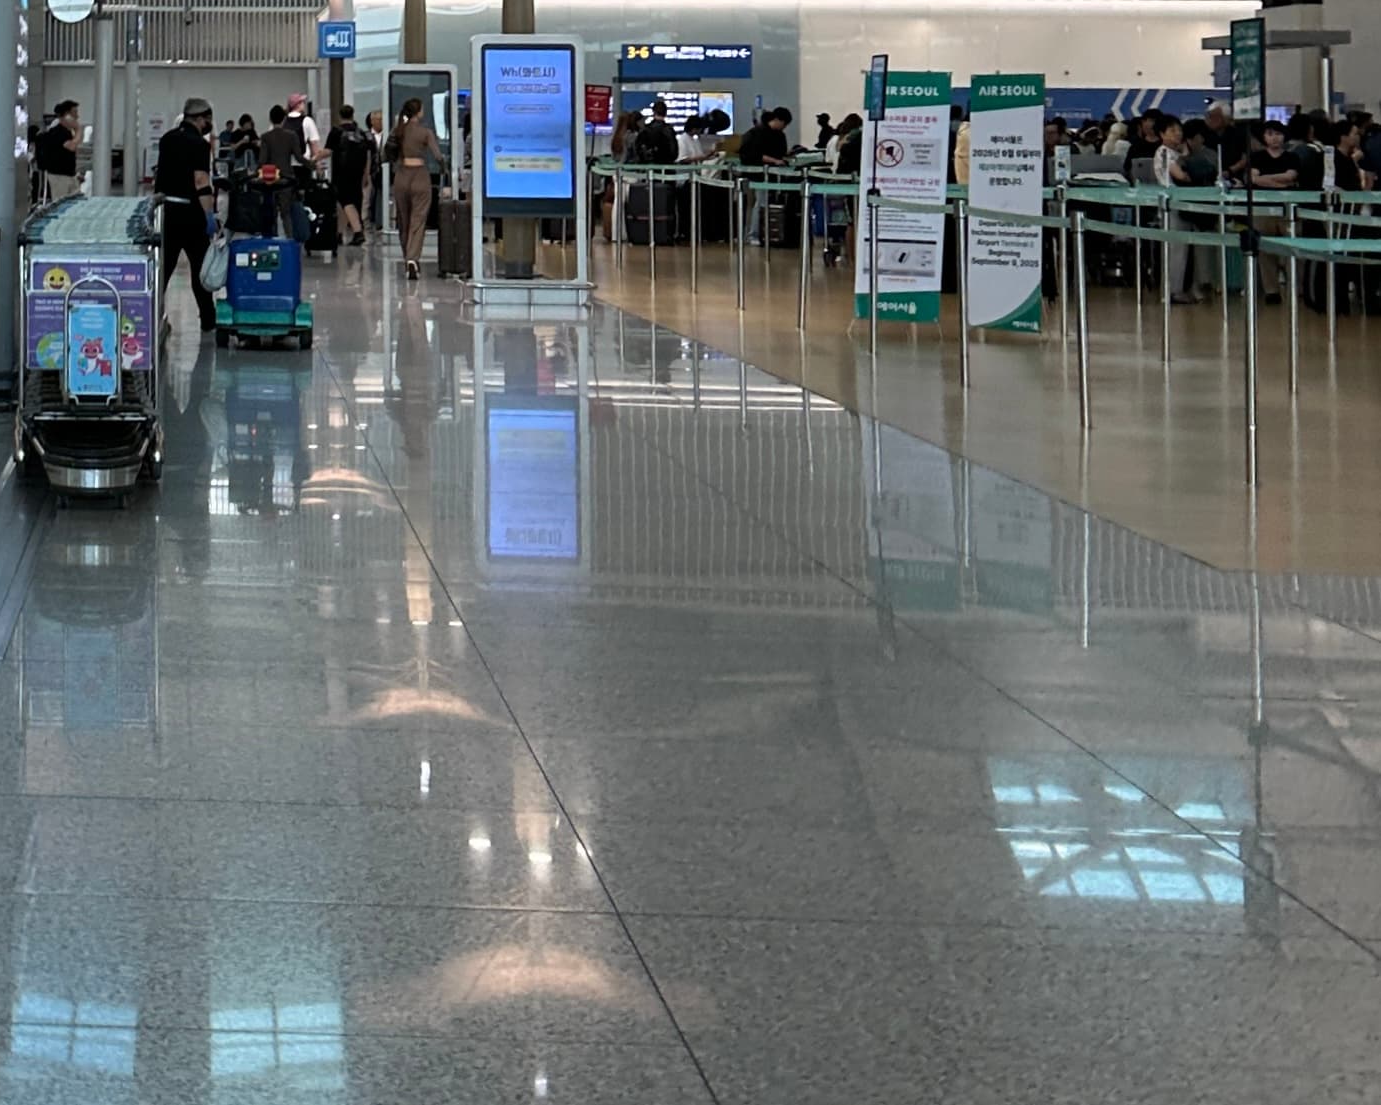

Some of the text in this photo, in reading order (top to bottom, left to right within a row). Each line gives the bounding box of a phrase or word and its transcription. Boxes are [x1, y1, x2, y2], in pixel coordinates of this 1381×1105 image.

[627, 46, 650, 59] 3-6
[901, 86, 939, 97] SEOUL
[979, 85, 1037, 97] AIR SEOUL
